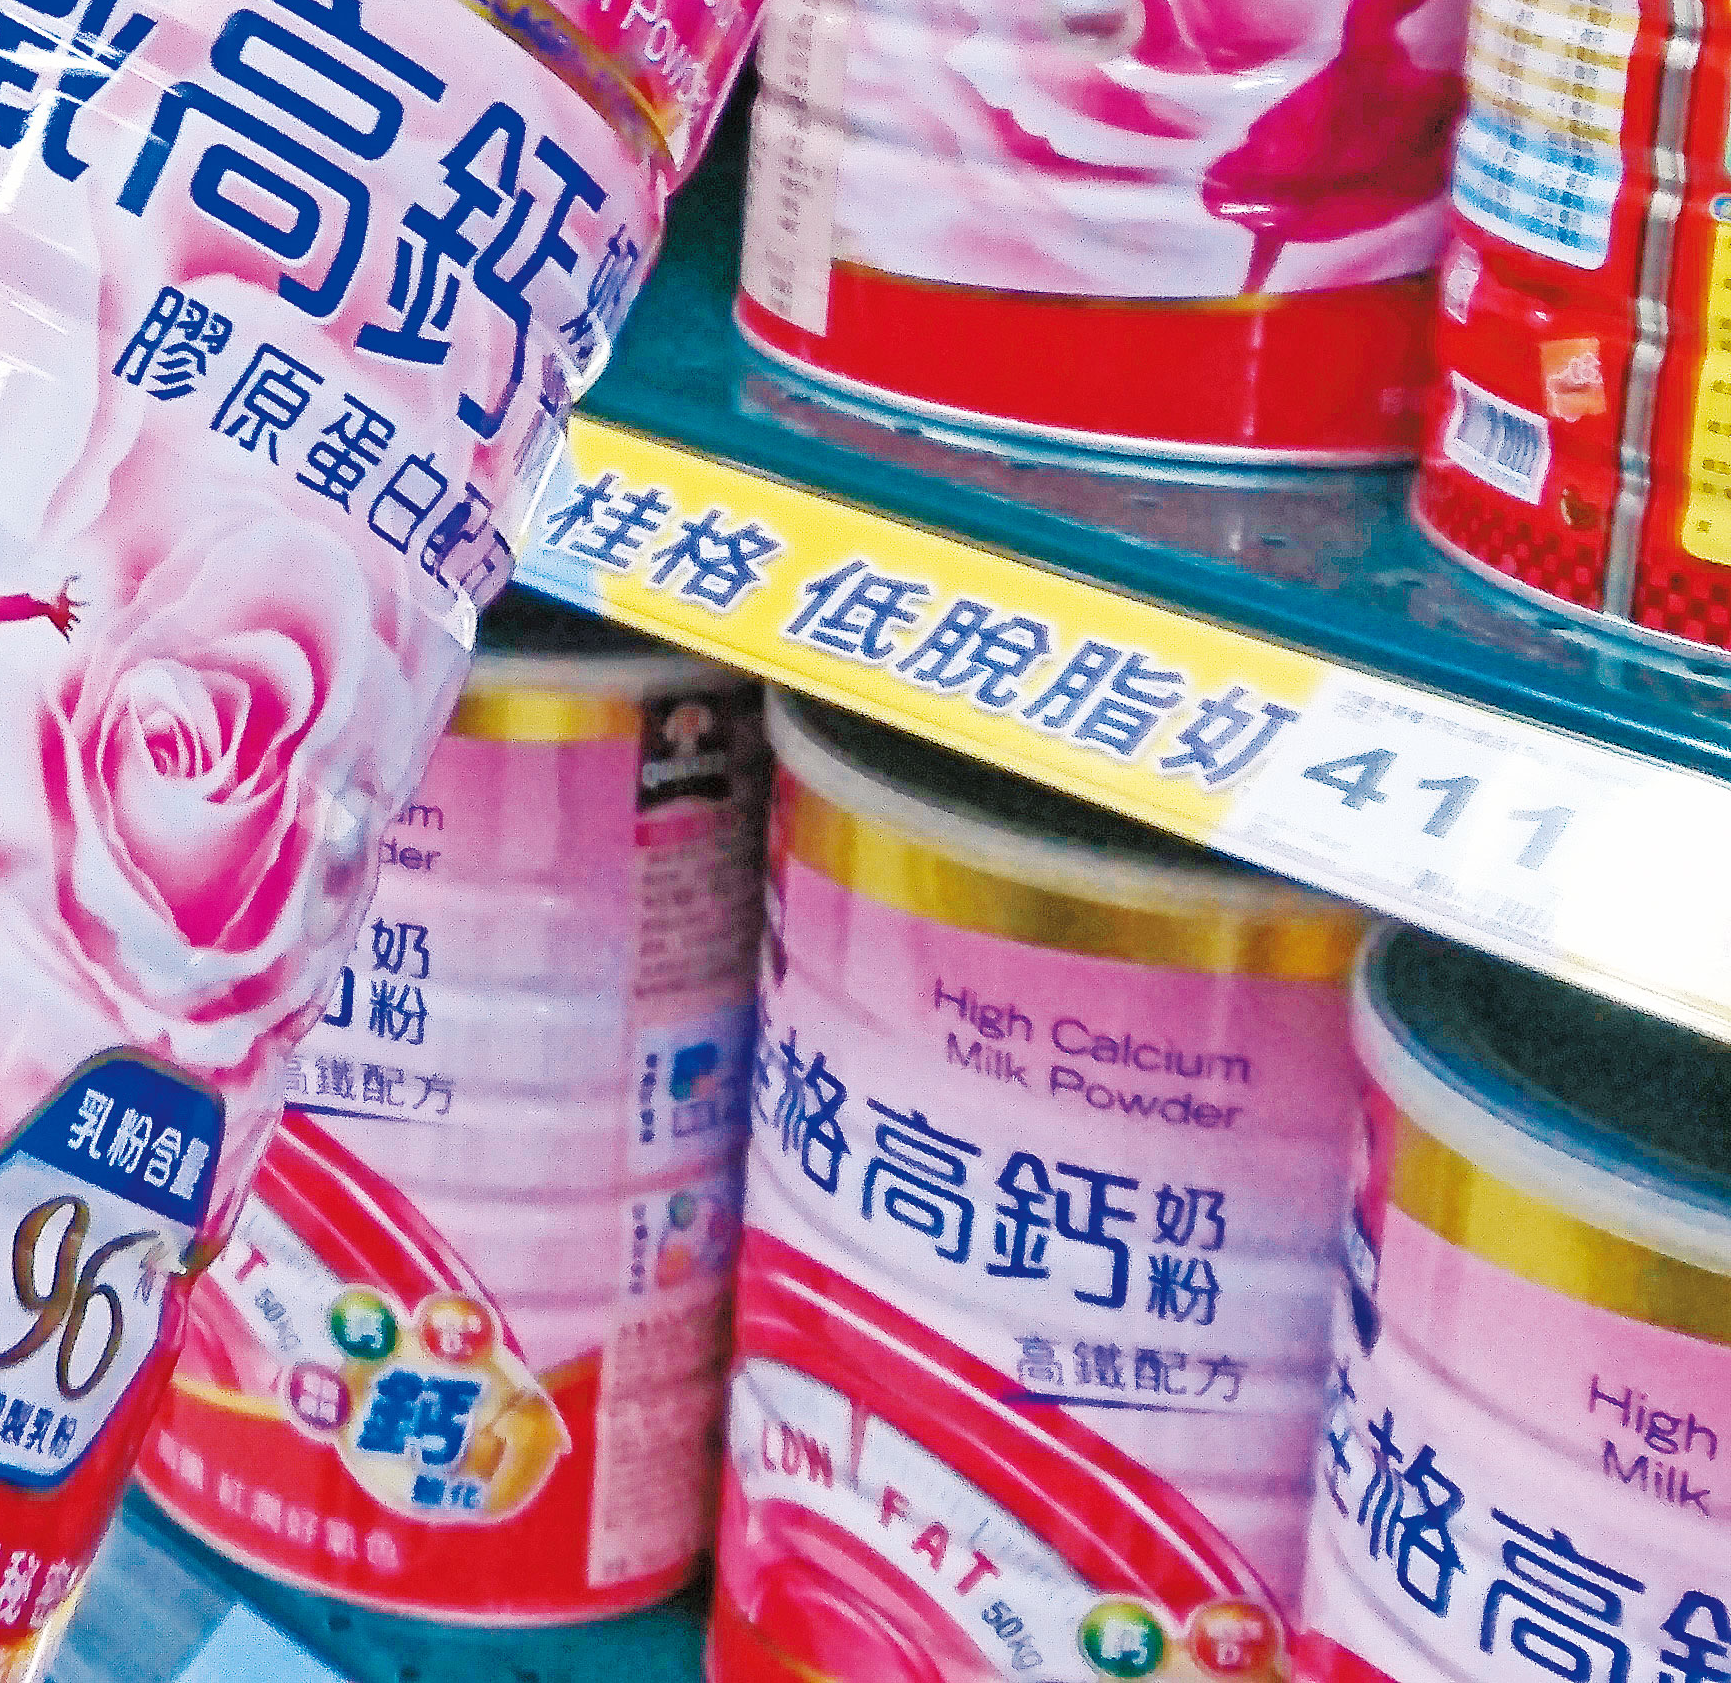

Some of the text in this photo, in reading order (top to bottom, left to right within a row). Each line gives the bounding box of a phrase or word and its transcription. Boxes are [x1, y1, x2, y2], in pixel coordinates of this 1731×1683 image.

[544, 470, 782, 607] 桂格
[1303, 747, 1577, 871] 411
[932, 978, 1252, 1086] High Calcium
[945, 1031, 1246, 1129] Milk Powder
[761, 1024, 1142, 1312] 格高鈣
[1143, 1181, 1227, 1328] 奶粉
[1588, 1373, 1719, 1462] High
[1331, 1379, 1731, 1683] 格高
[1601, 1438, 1712, 1519] Milk
[876, 1484, 1003, 1598] FAT
